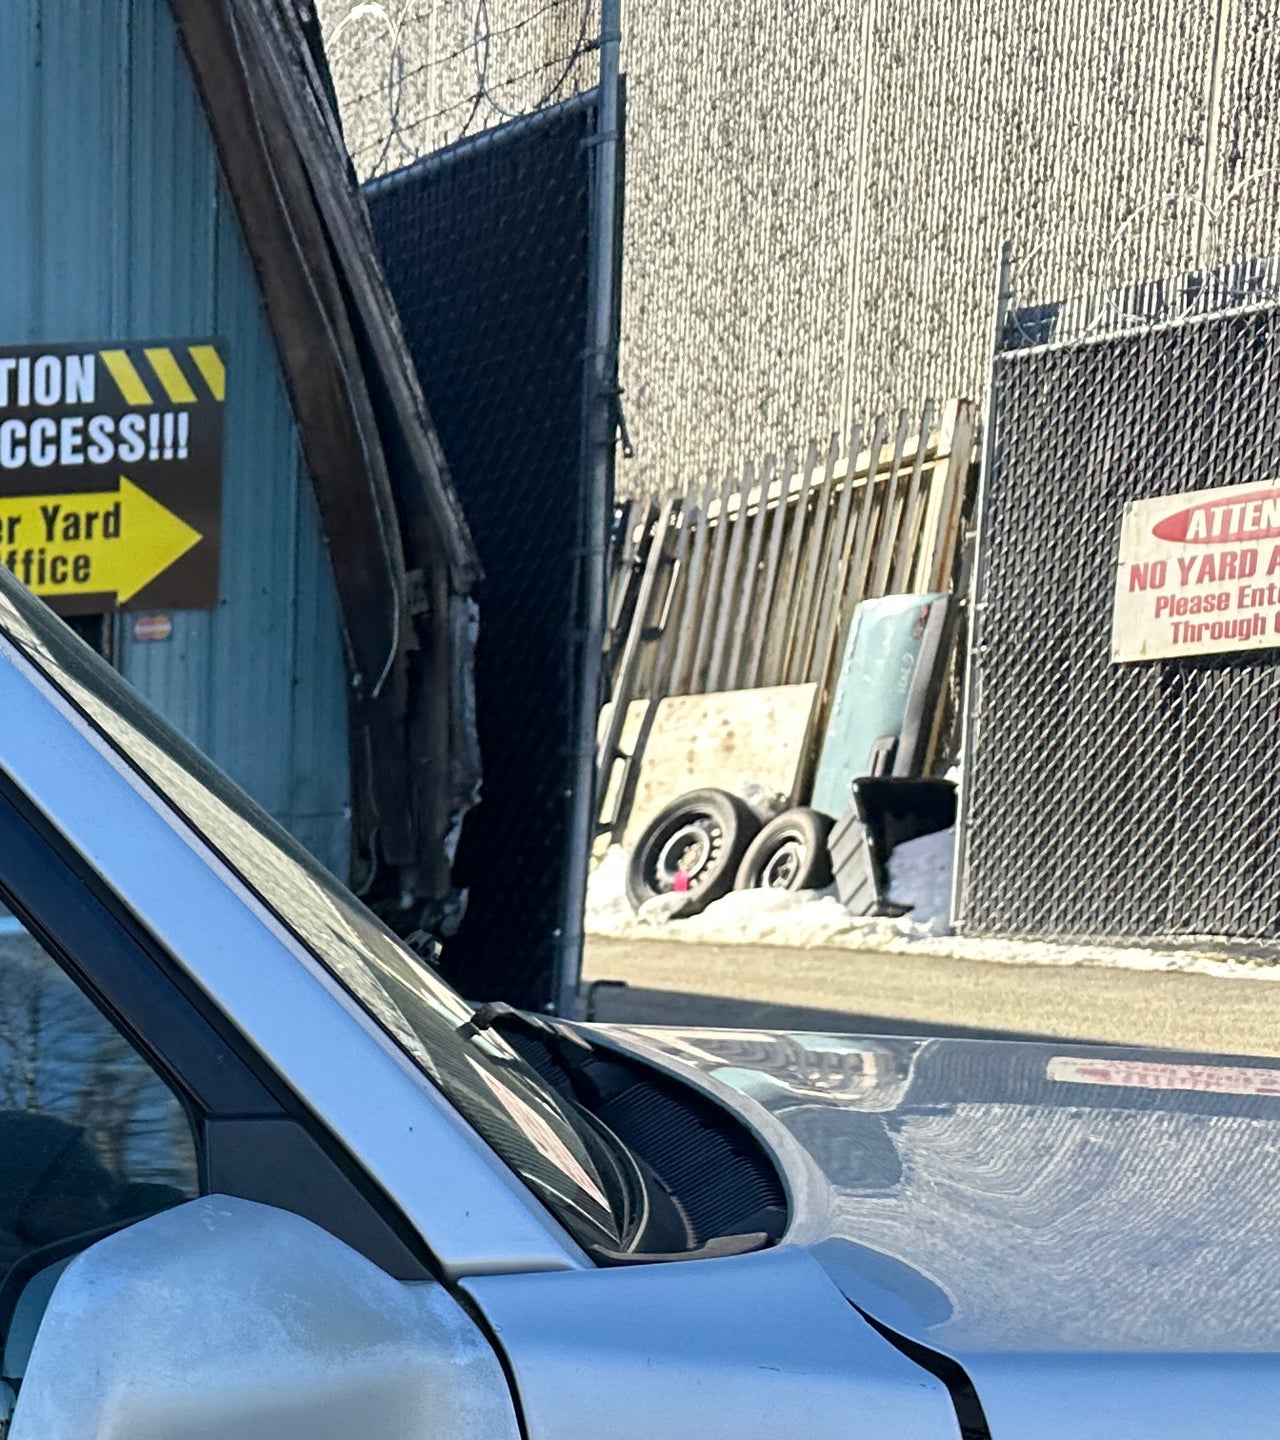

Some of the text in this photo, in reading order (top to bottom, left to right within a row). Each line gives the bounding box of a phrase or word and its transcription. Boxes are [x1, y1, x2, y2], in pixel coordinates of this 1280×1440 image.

[40, 502, 122, 543] Yard
[1129, 561, 1168, 593] NO
[1177, 548, 1258, 587] YARD
[1155, 582, 1280, 619] Please Ent
[1171, 613, 1267, 645] Through
